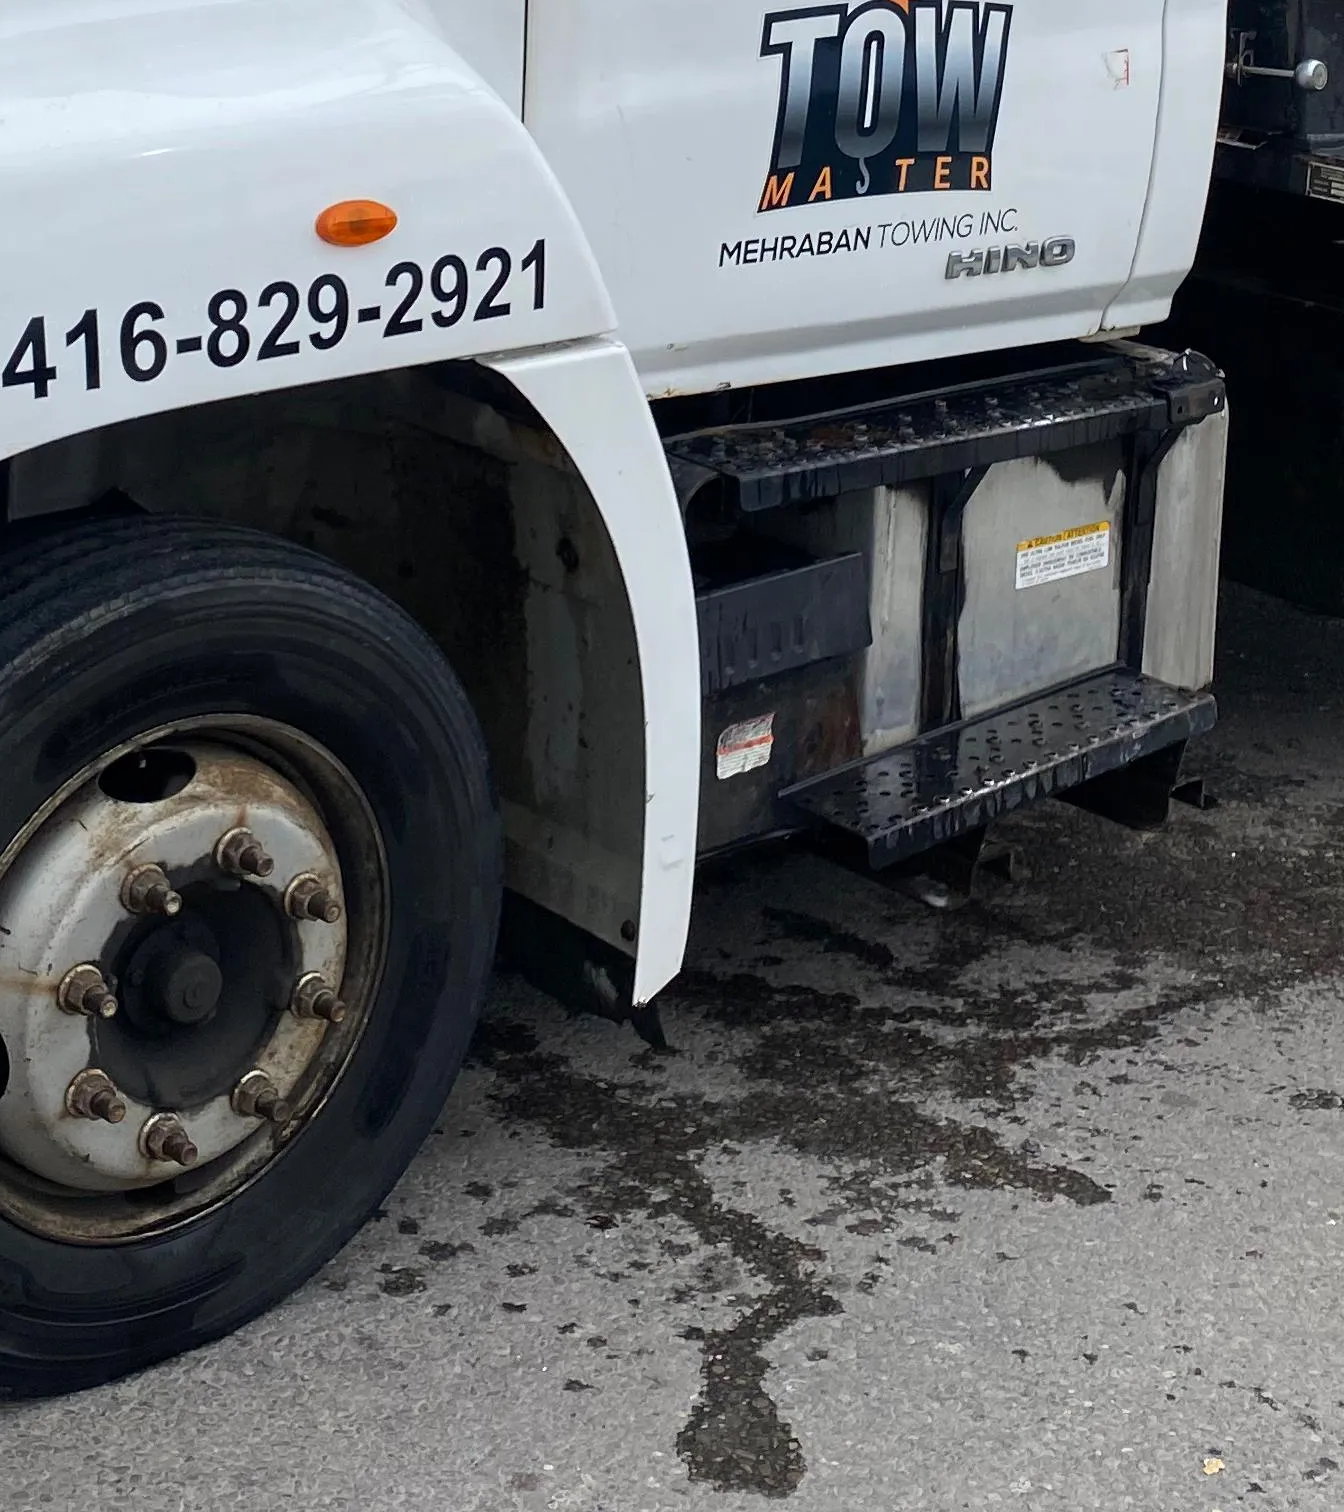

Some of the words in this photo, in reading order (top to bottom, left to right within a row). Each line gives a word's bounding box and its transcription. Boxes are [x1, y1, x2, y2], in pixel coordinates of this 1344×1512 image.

[760, 155, 991, 211] MASTER
[718, 226, 872, 268] MEHRABAN
[877, 213, 973, 249] TOWING
[978, 208, 1019, 235] INC.
[945, 234, 1076, 280] HINO
[2, 238, 546, 399] 416-829-2921
